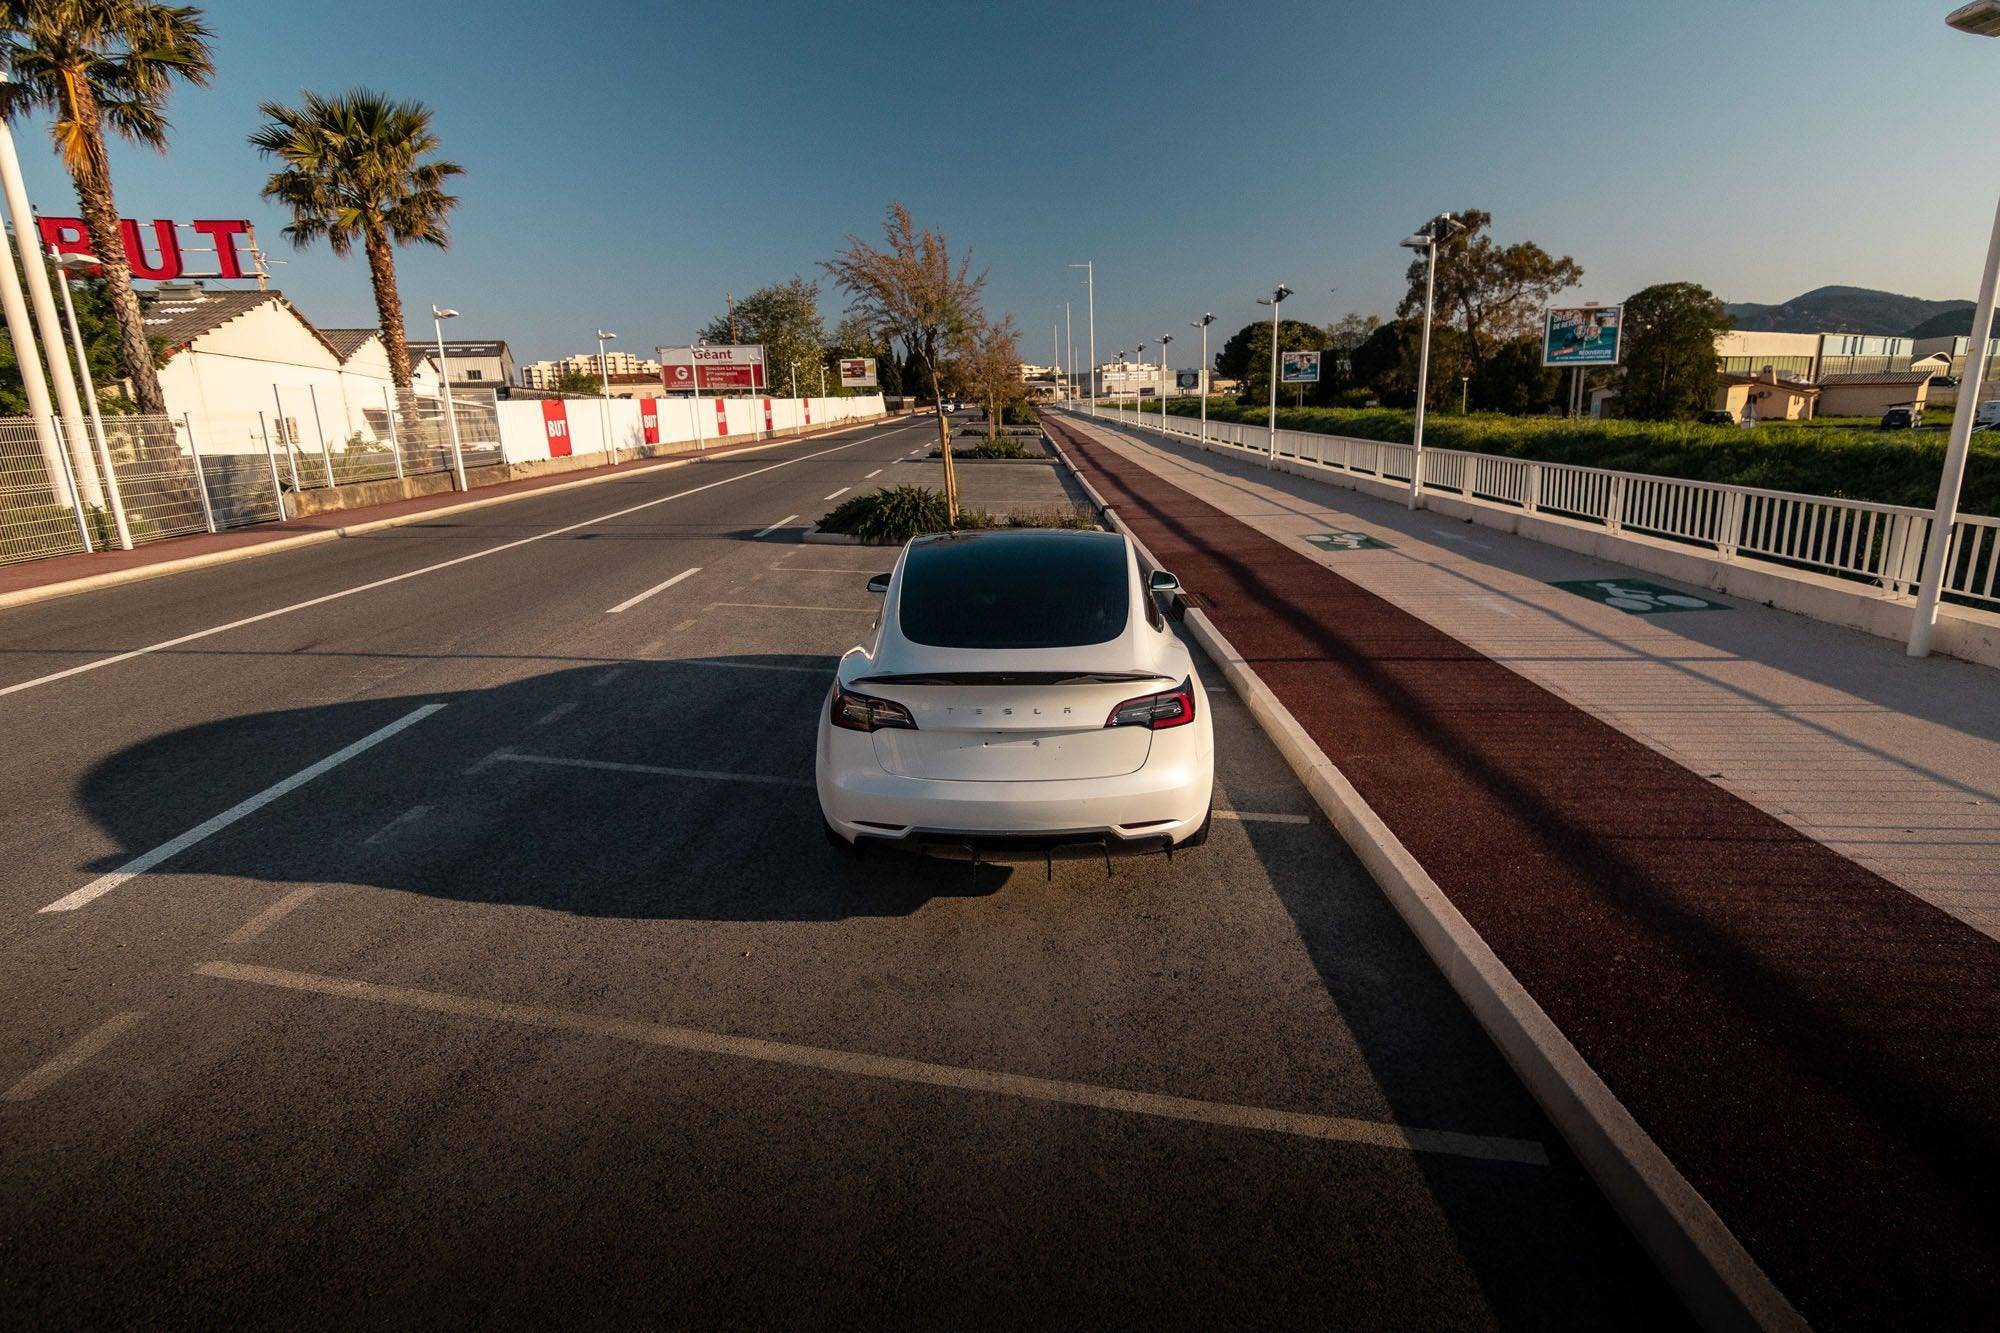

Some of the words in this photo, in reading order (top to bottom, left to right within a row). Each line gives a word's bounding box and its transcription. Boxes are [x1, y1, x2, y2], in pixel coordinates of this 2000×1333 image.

[37, 216, 249, 280] BUT
[693, 350, 732, 359] Géant
[547, 419, 567, 438] BUT
[643, 413, 657, 429] BUT
[946, 707, 1072, 715] TESLA
